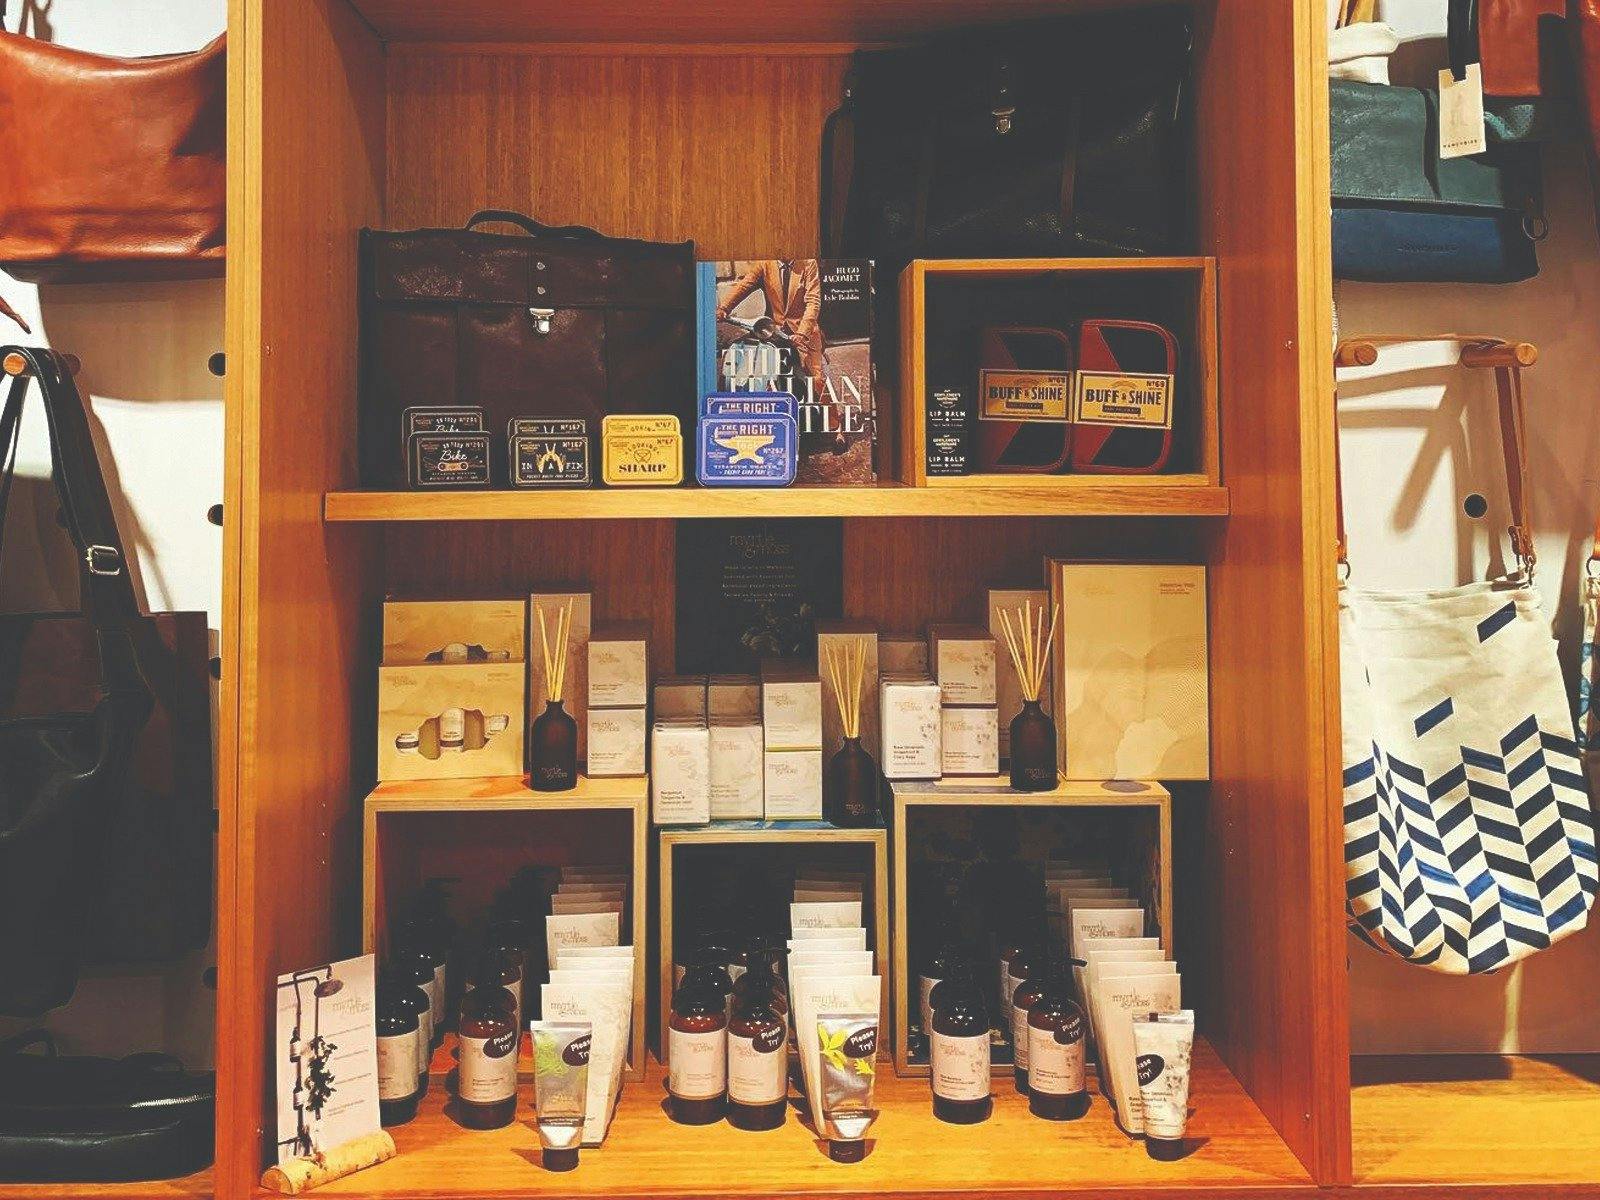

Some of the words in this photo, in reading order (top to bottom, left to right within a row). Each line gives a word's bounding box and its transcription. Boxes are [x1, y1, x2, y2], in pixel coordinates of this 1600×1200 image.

[823, 274, 861, 283] JACOMET
[989, 385, 1022, 399] BUFF
[1031, 386, 1063, 400] SHINE
[1085, 388, 1119, 403] BUFF
[1128, 390, 1162, 406] SHINE
[743, 402, 777, 414] RIGHT
[739, 425, 774, 435] RIGHT
[439, 450, 468, 461] Bike
[521, 462, 533, 470] IN
[548, 462, 554, 470] A
[566, 462, 584, 470] FIX
[618, 464, 667, 473] SHARP
[760, 1026, 780, 1040] Please
[850, 1030, 875, 1045] Please
[858, 1041, 874, 1052] Try!
